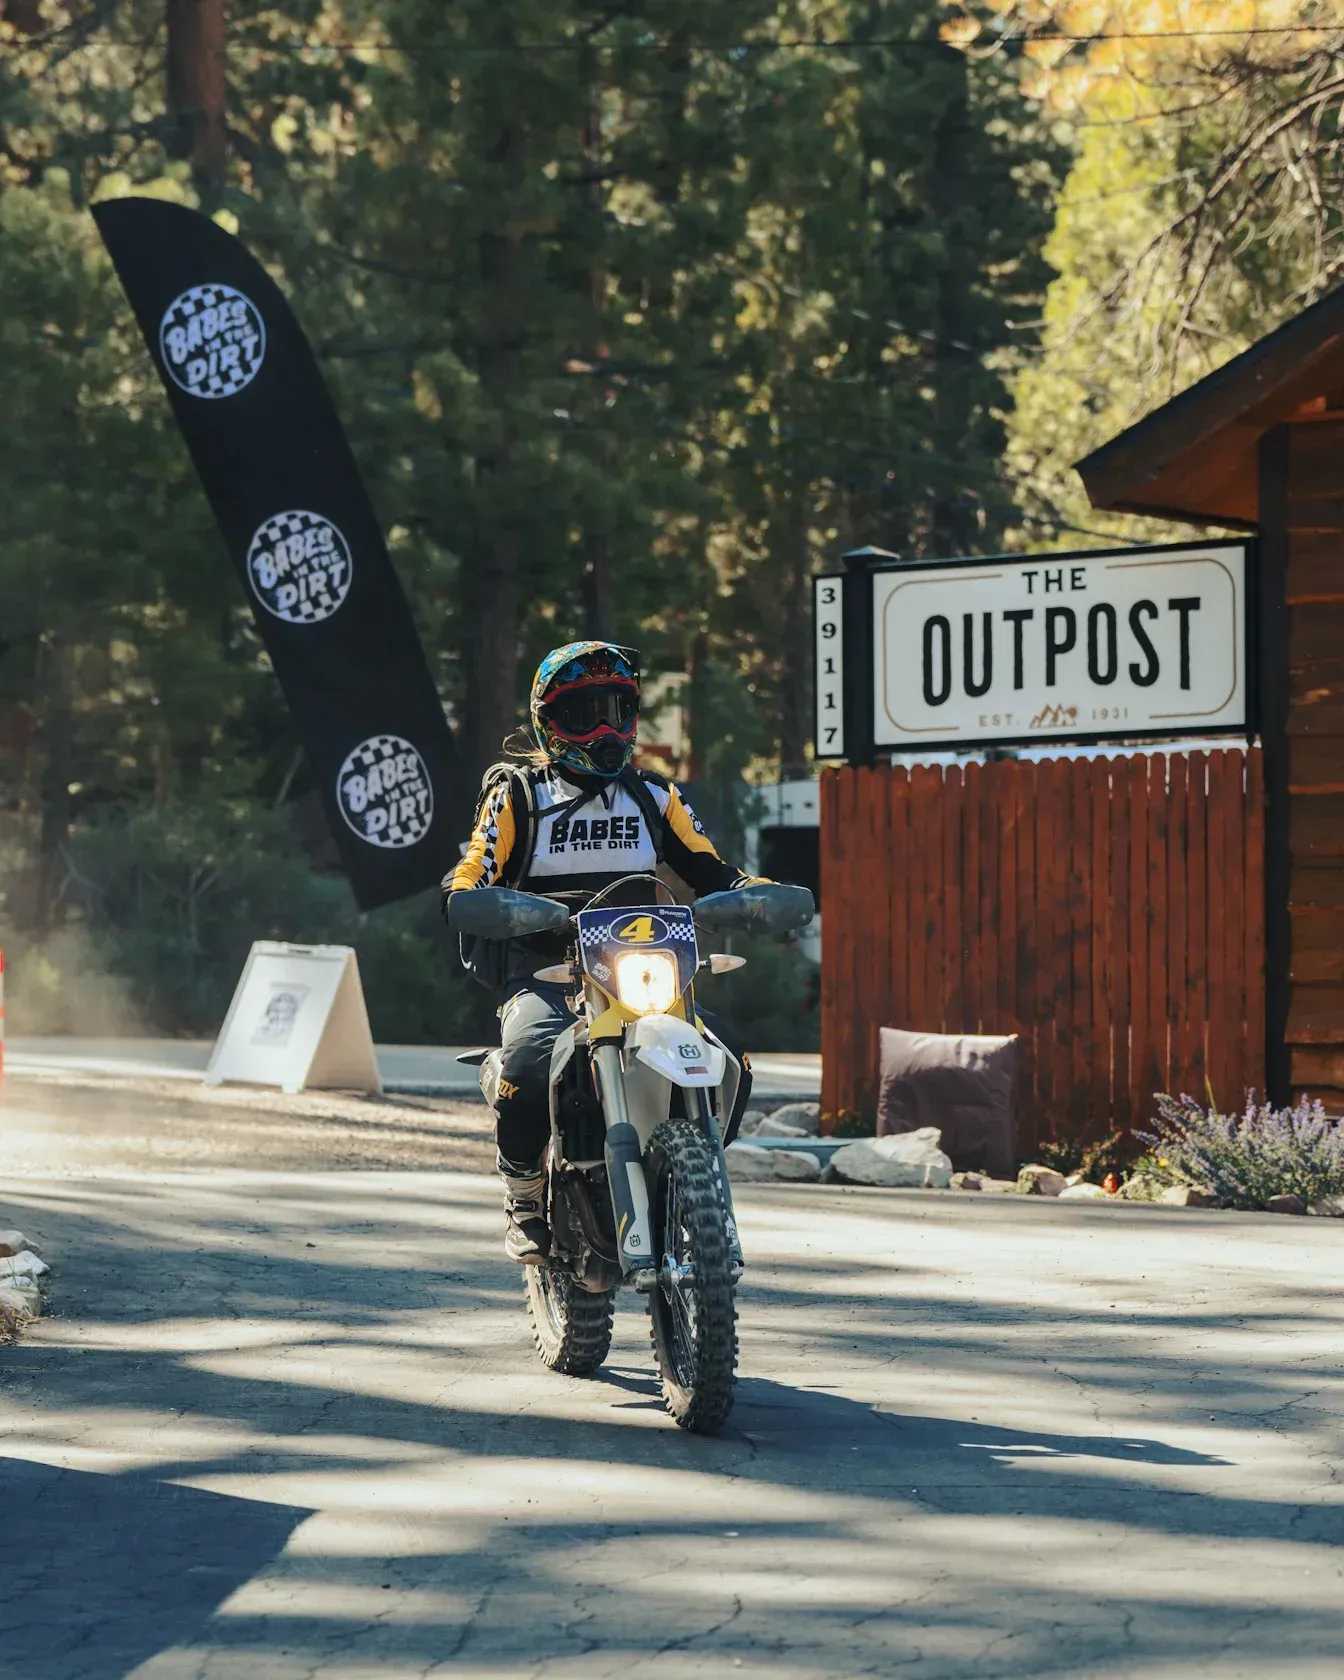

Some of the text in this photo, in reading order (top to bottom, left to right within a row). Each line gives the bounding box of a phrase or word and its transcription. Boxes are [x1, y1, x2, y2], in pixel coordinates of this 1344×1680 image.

[166, 300, 248, 364] BABES
[186, 334, 259, 385] DIRT
[252, 527, 334, 589] BABES
[1022, 567, 1087, 594] THE
[276, 561, 346, 609] DIRT
[821, 587, 838, 744] 39117
[922, 597, 1201, 706] OUTPOST
[979, 706, 1129, 727] EST. 1931
[342, 753, 419, 813] BABES
[364, 788, 428, 835] DIRT
[550, 816, 640, 845] BABES
[549, 840, 640, 854] IN THE DIRT
[619, 916, 655, 943] 4
